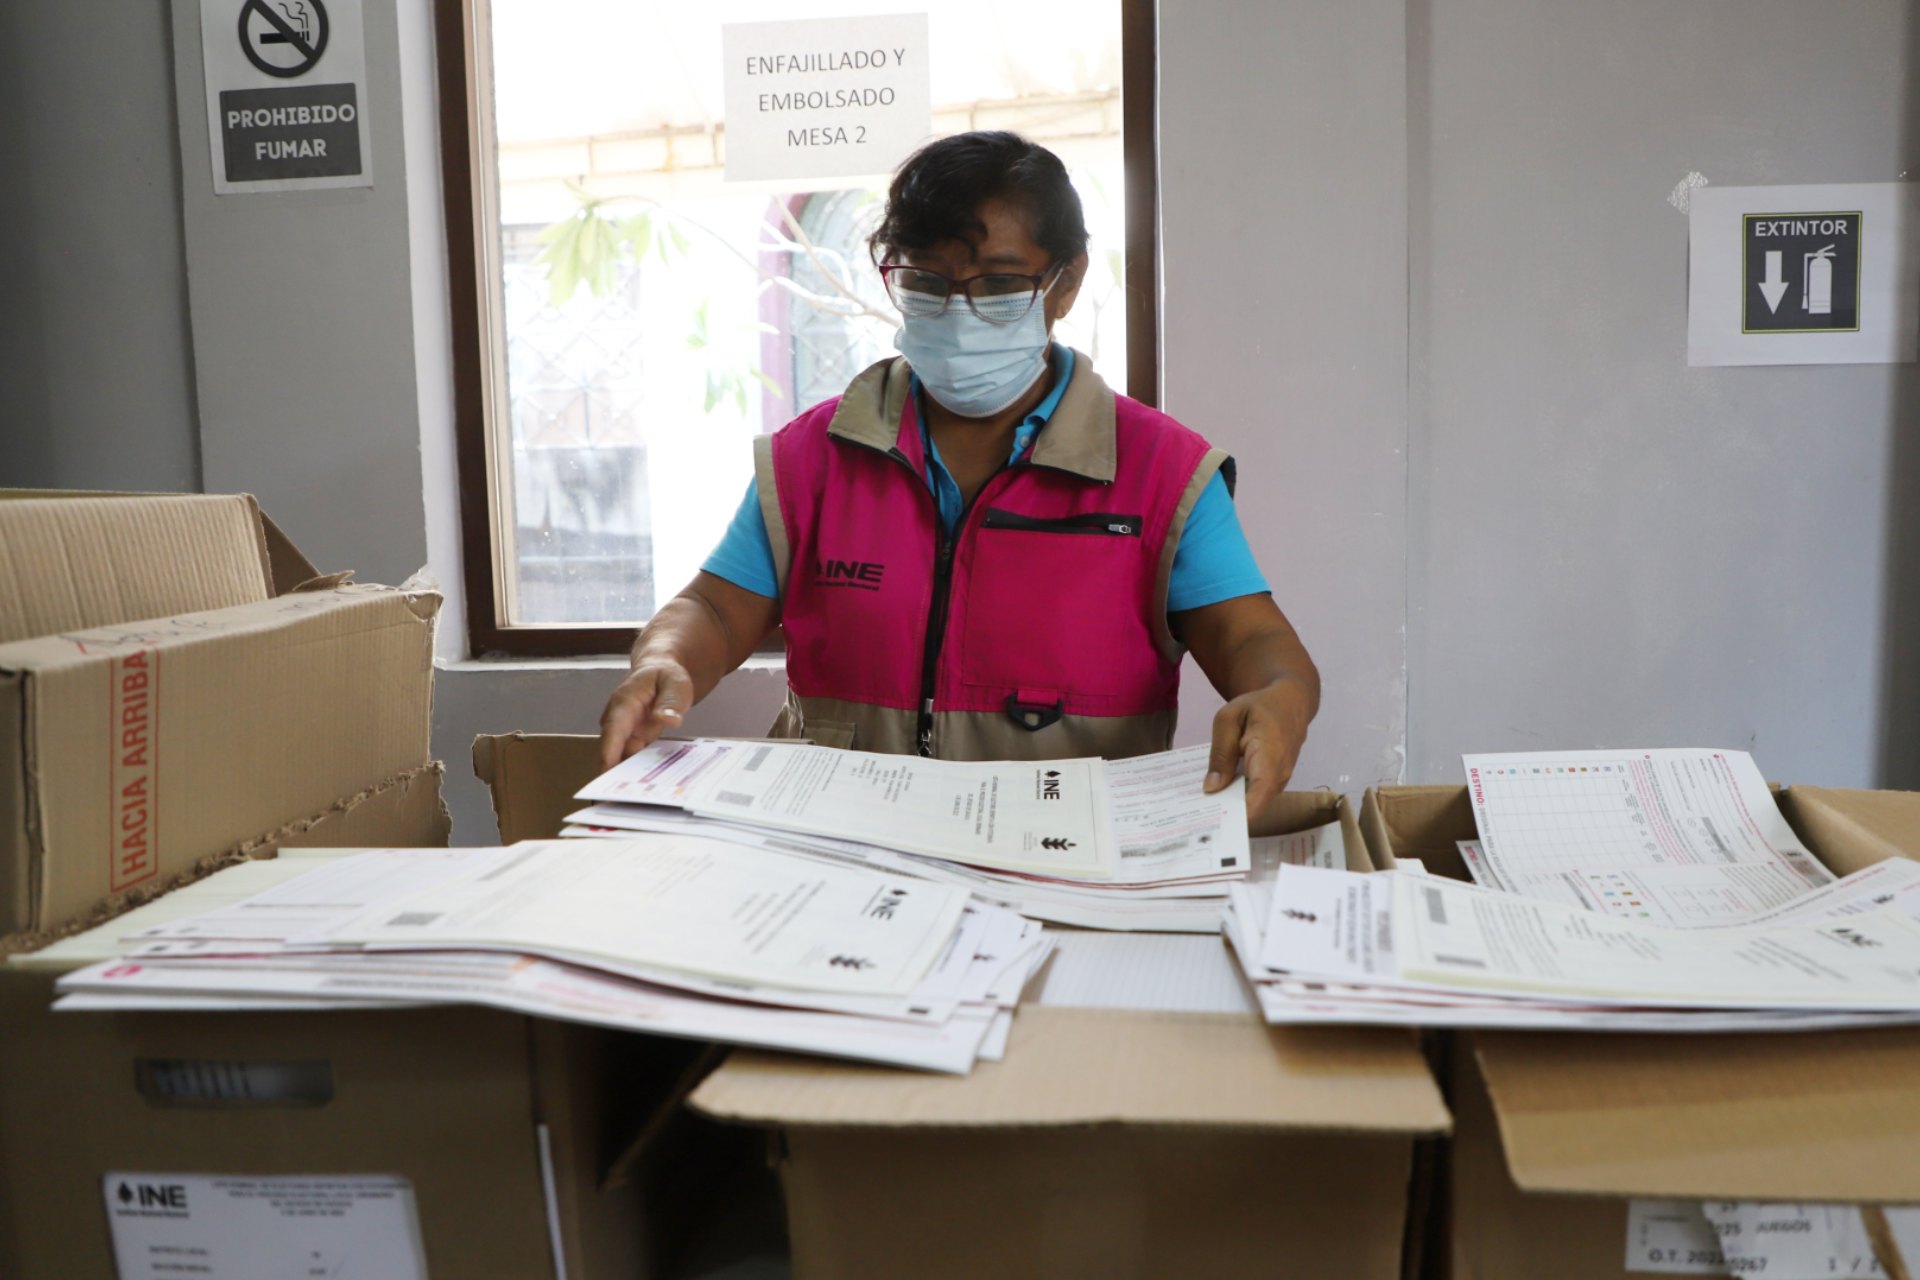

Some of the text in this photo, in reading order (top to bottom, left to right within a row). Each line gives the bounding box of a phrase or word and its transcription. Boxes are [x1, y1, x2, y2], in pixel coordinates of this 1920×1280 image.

[746, 48, 905, 75] ENFAJILLADO Y
[759, 87, 895, 112] EMBOLSADO
[226, 104, 356, 129] PROHIBIDO
[788, 126, 867, 146] MESA 2
[255, 138, 327, 160] FUMAR
[1754, 220, 1848, 237] EXTINTOR
[826, 559, 885, 583] INE
[122, 649, 148, 877] HACIA ARRIBA
[1043, 779, 1060, 800] INE
[137, 1184, 188, 1210] INE
